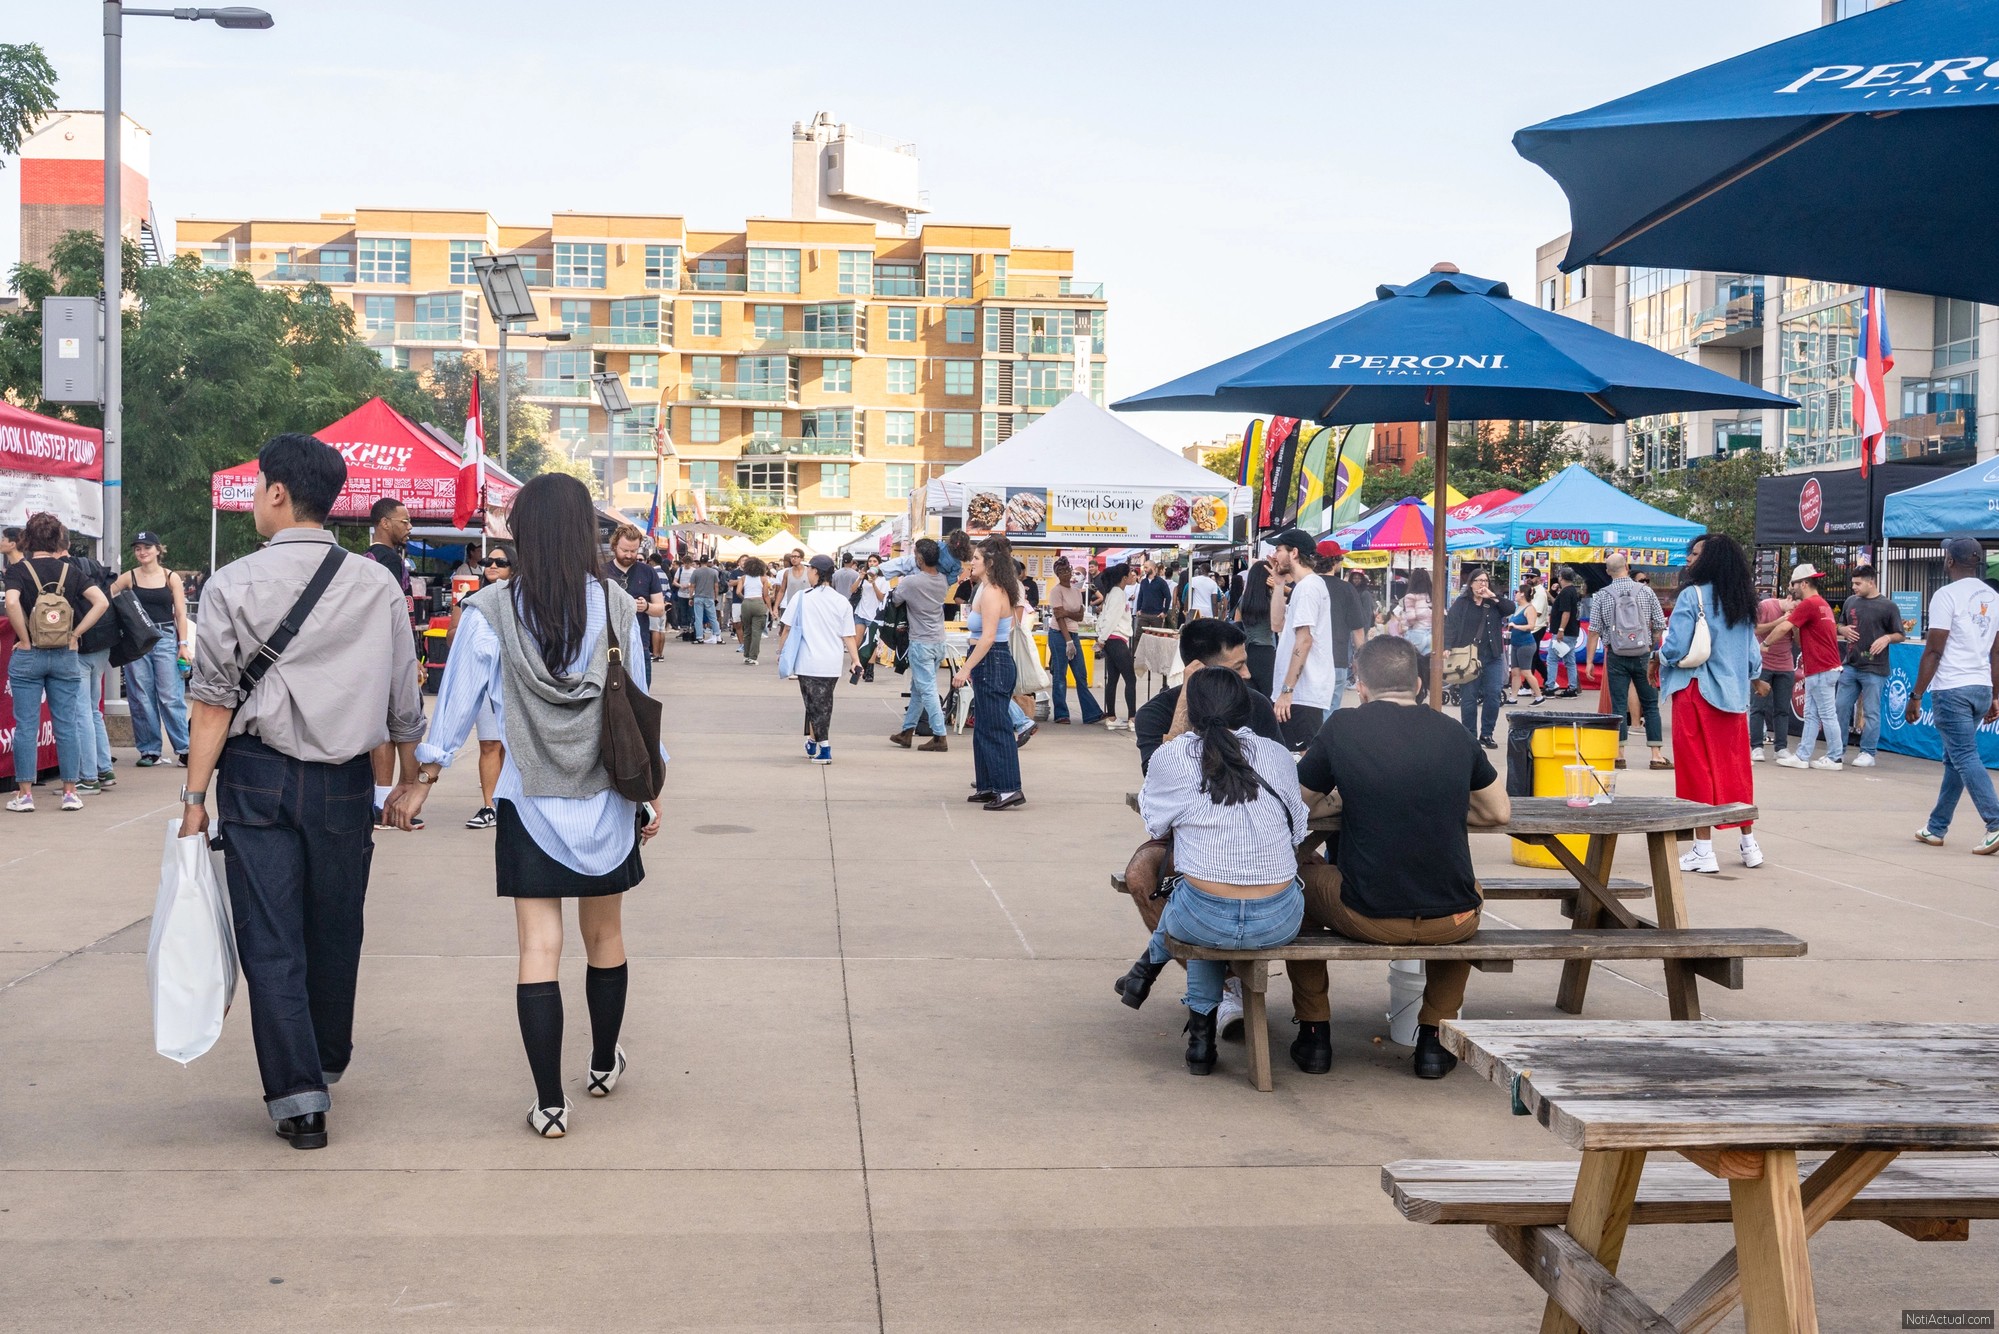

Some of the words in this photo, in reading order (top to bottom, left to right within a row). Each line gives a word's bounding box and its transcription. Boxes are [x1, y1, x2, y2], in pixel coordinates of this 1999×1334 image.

[1328, 354, 1508, 369] PERONI
[23, 428, 66, 461] LOBSTER
[67, 437, 96, 466] POUND
[326, 442, 413, 467] KHUY
[362, 461, 407, 472] CUISINE
[236, 488, 255, 498] Mik
[1805, 485, 1815, 498] THE
[1057, 494, 1099, 510] Knead
[1103, 495, 1144, 512] Some
[1801, 494, 1820, 512] PINCHO
[1803, 507, 1819, 522] TRUCK
[1525, 528, 1591, 545] CAFECITO
